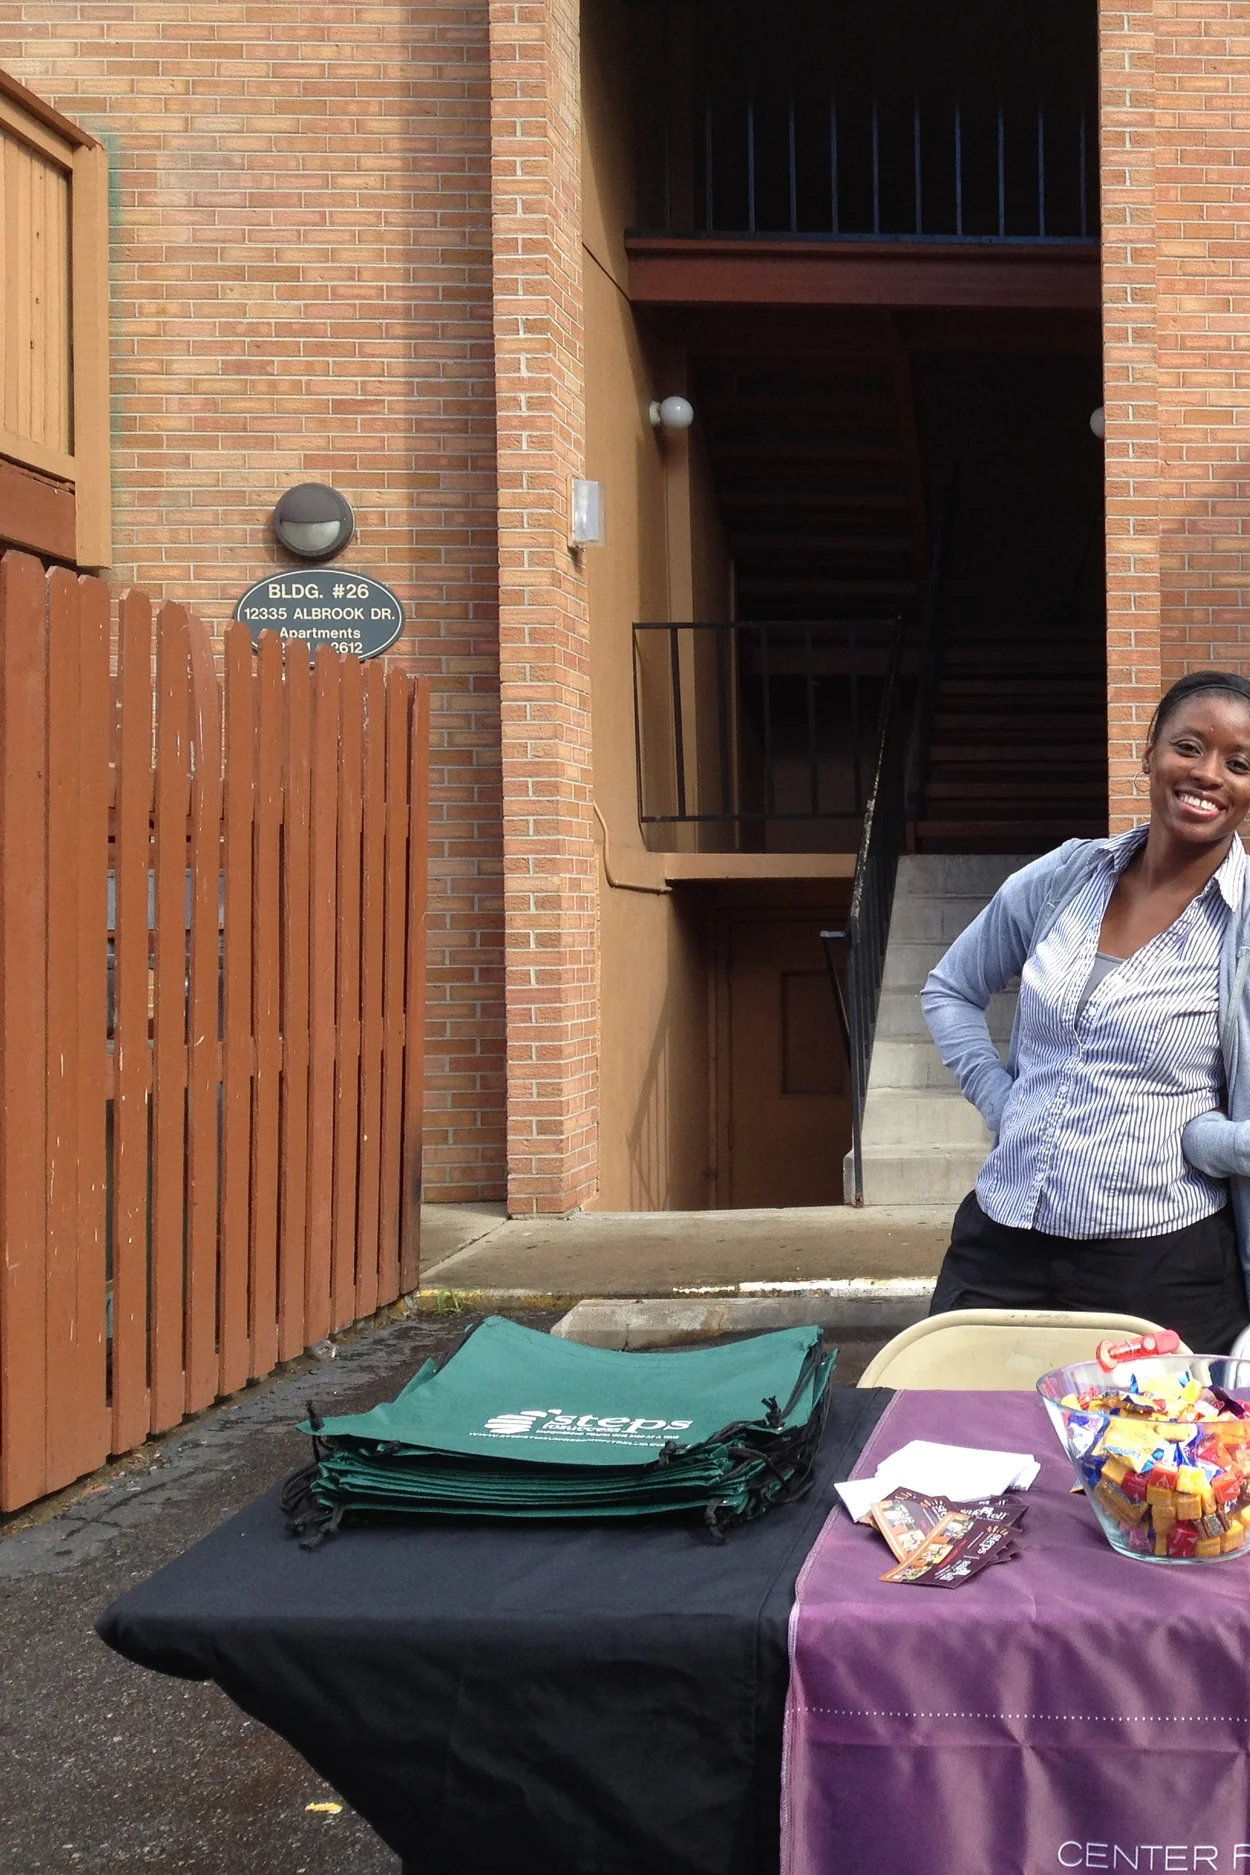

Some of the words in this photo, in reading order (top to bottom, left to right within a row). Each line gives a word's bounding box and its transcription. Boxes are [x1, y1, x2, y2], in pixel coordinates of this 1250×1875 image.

[268, 583, 323, 599] BLDG.
[332, 583, 369, 599] #26
[244, 608, 287, 620] 12335
[293, 607, 364, 620] ALBROOK
[371, 607, 396, 620] DR.
[551, 1414, 693, 1433] steps
[1056, 1840, 1218, 1874] CENTER
